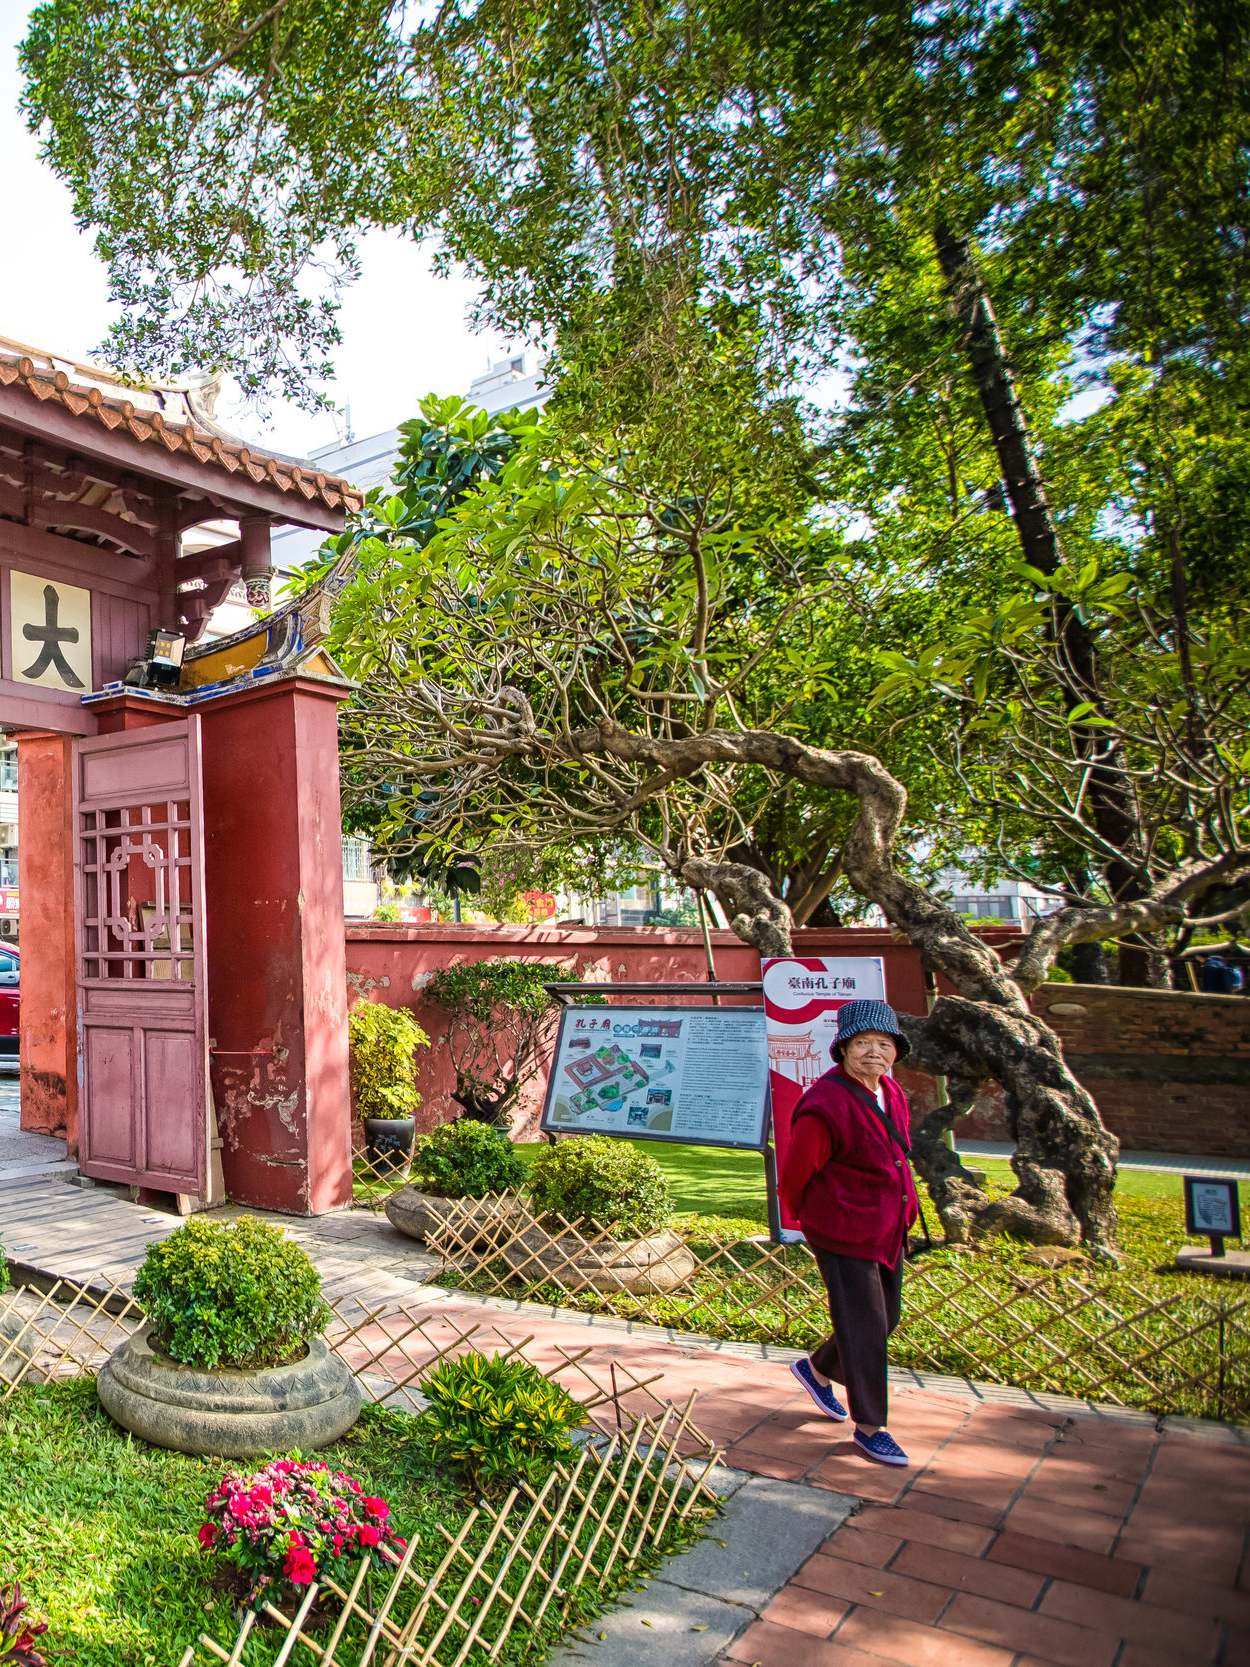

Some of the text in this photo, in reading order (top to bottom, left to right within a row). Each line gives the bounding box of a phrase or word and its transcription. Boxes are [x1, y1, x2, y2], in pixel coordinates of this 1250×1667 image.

[788, 976, 856, 990] 臺南孔子廟
